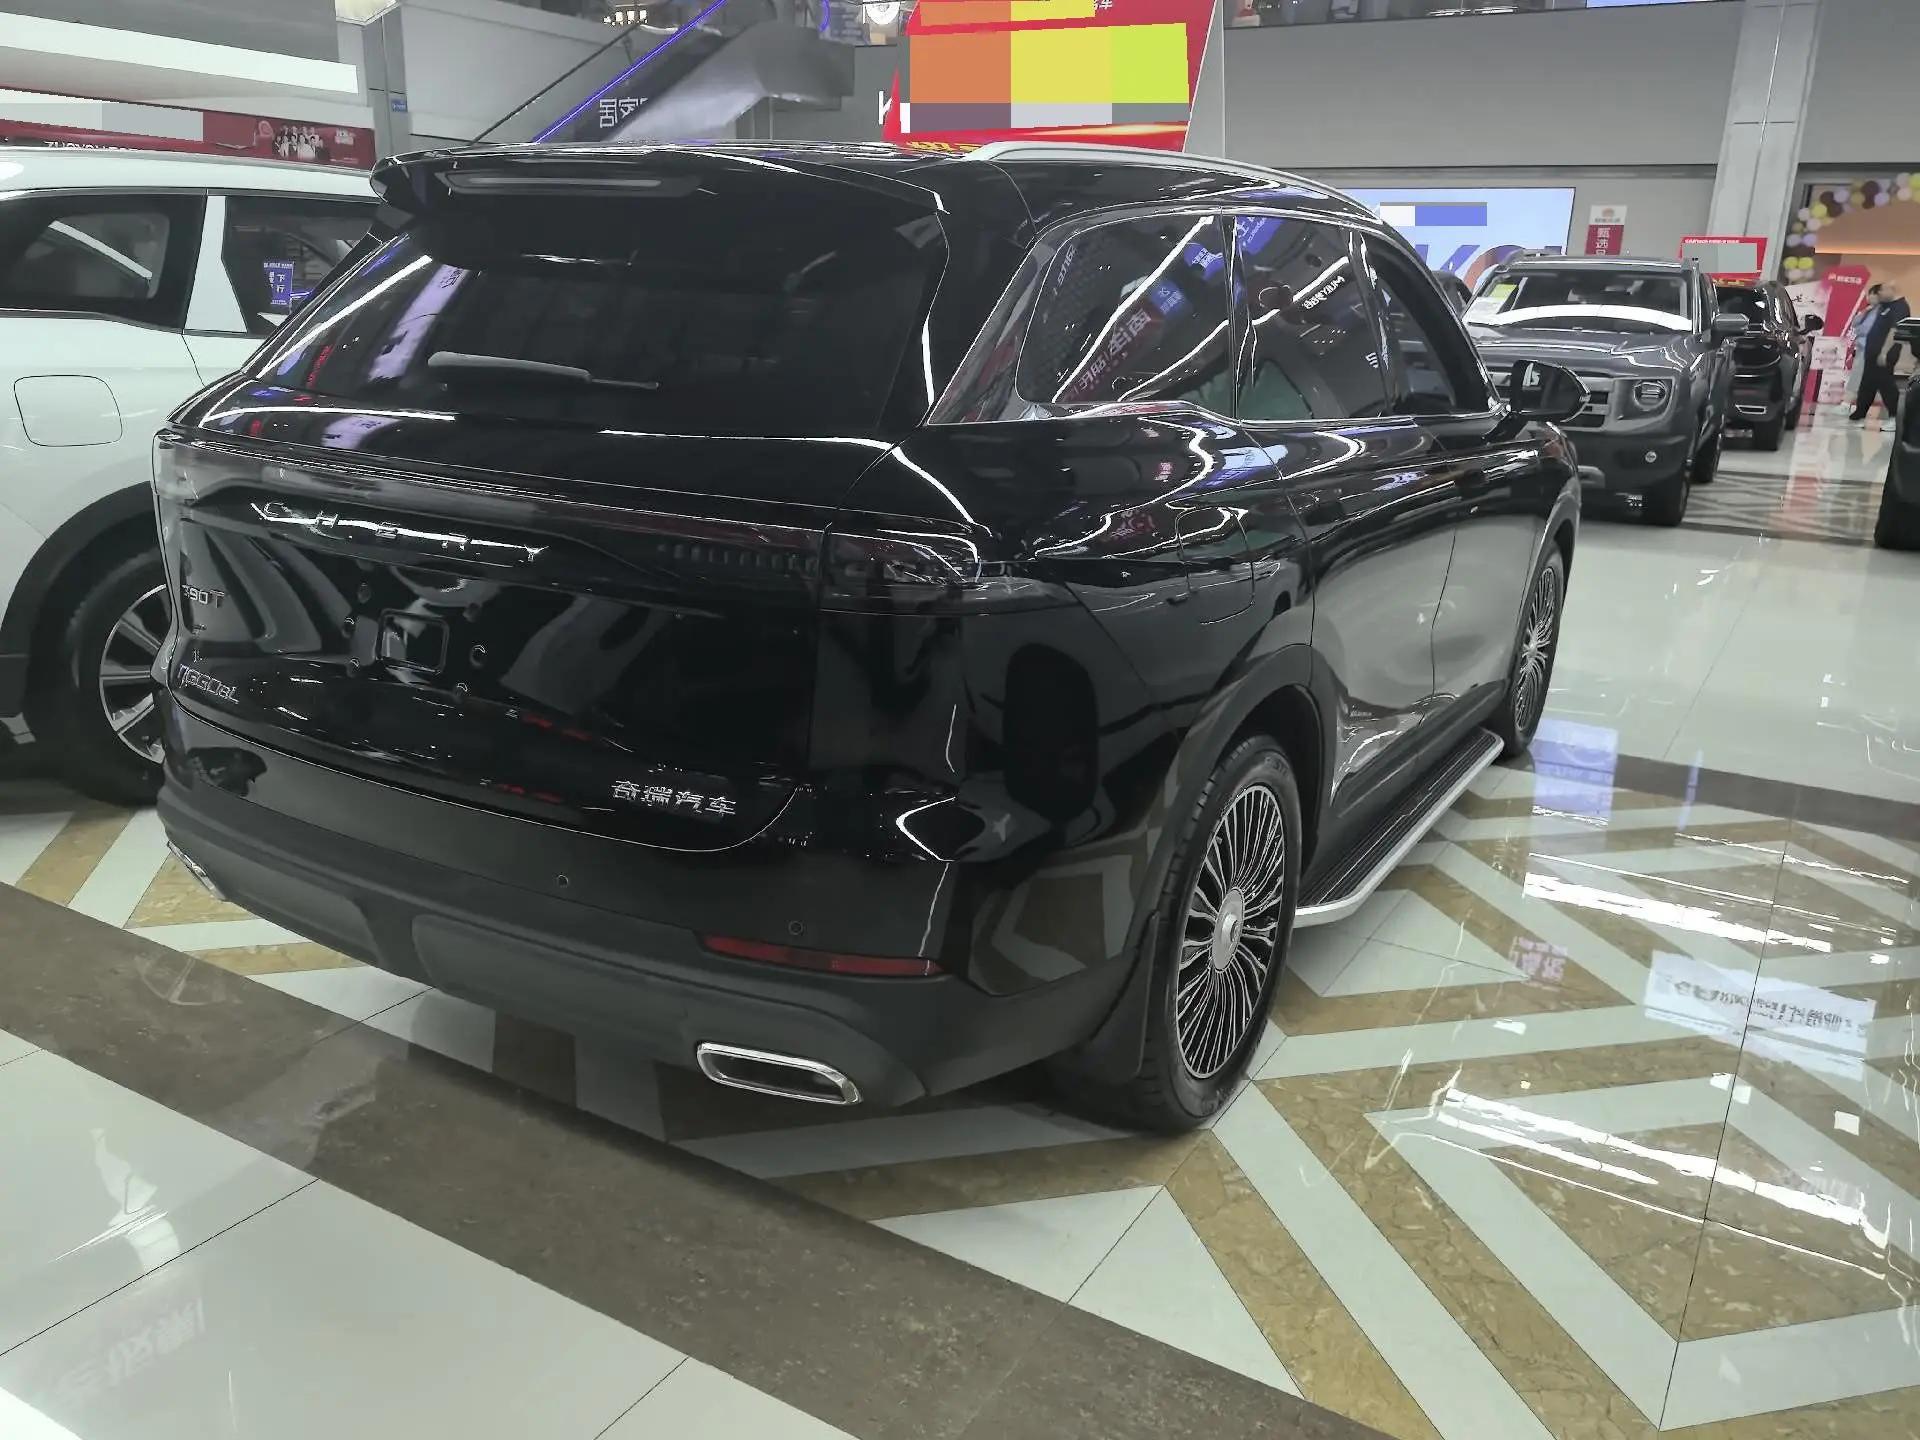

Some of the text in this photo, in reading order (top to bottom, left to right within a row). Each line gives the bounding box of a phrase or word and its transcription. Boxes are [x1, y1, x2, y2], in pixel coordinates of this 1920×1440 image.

[263, 502, 550, 562] CHERY
[610, 779, 737, 816] 奇瑞汽车
